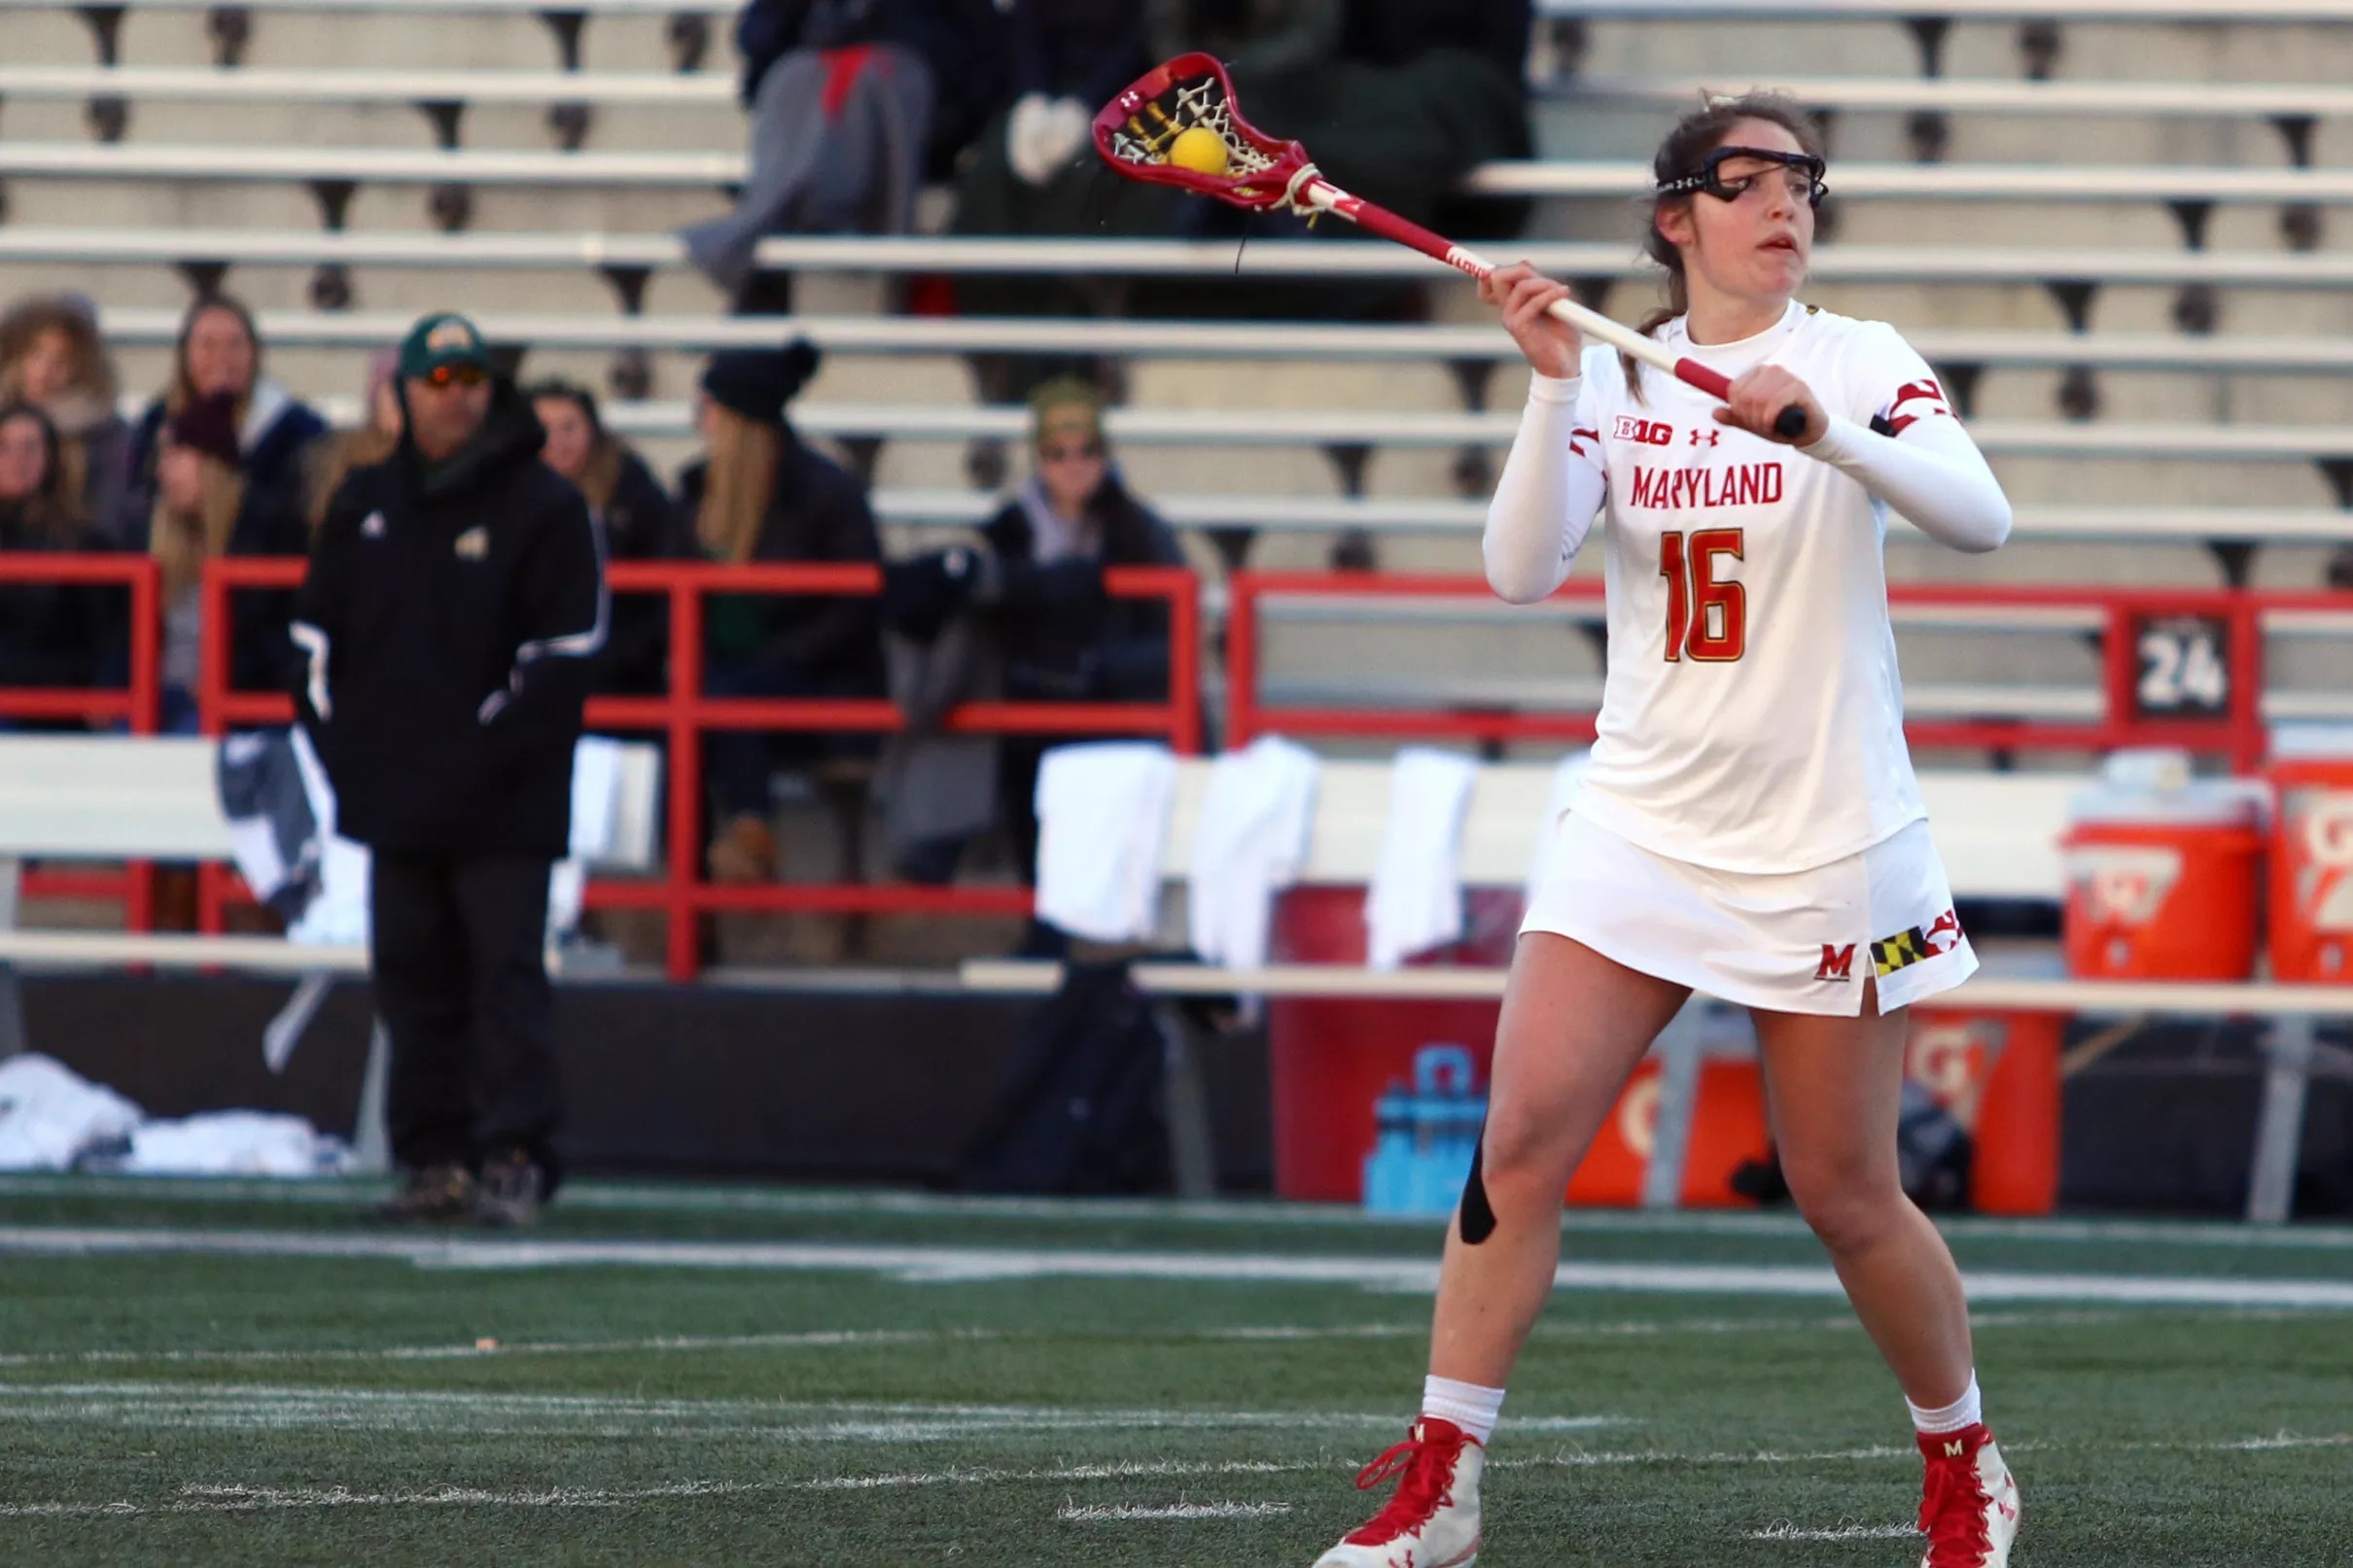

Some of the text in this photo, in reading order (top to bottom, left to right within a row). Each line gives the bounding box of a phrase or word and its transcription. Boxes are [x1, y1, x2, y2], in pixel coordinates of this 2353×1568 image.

[1630, 462, 1782, 508] MARYLAND
[1660, 528, 1746, 663] 16
[2140, 634, 2227, 707] 24
[1814, 943, 1857, 981] M
[1944, 1439, 1963, 1457] M
